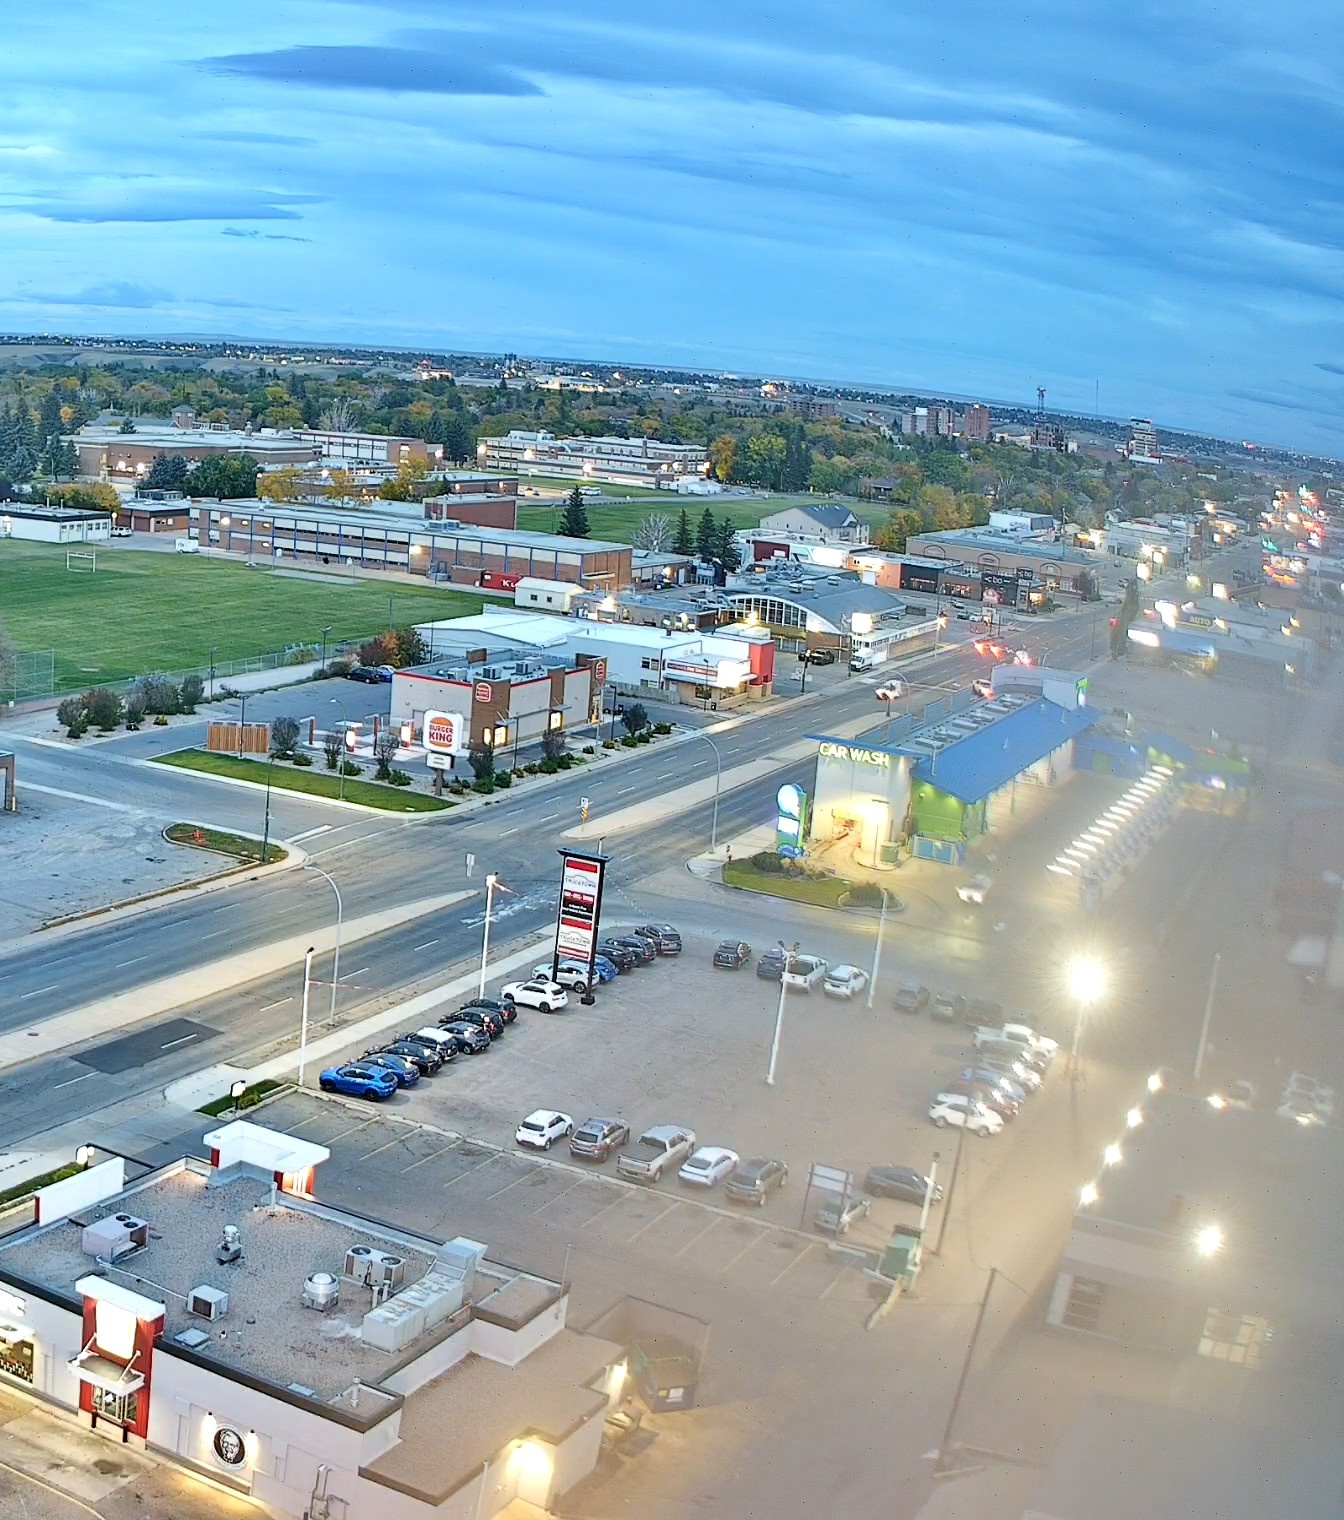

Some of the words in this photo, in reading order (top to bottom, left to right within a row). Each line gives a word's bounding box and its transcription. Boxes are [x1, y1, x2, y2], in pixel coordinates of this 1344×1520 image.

[1189, 615, 1212, 626] AUTO
[429, 724, 453, 734] BURGER
[429, 731, 453, 743] KING
[819, 742, 848, 760] CAR
[849, 747, 890, 768] WASH
